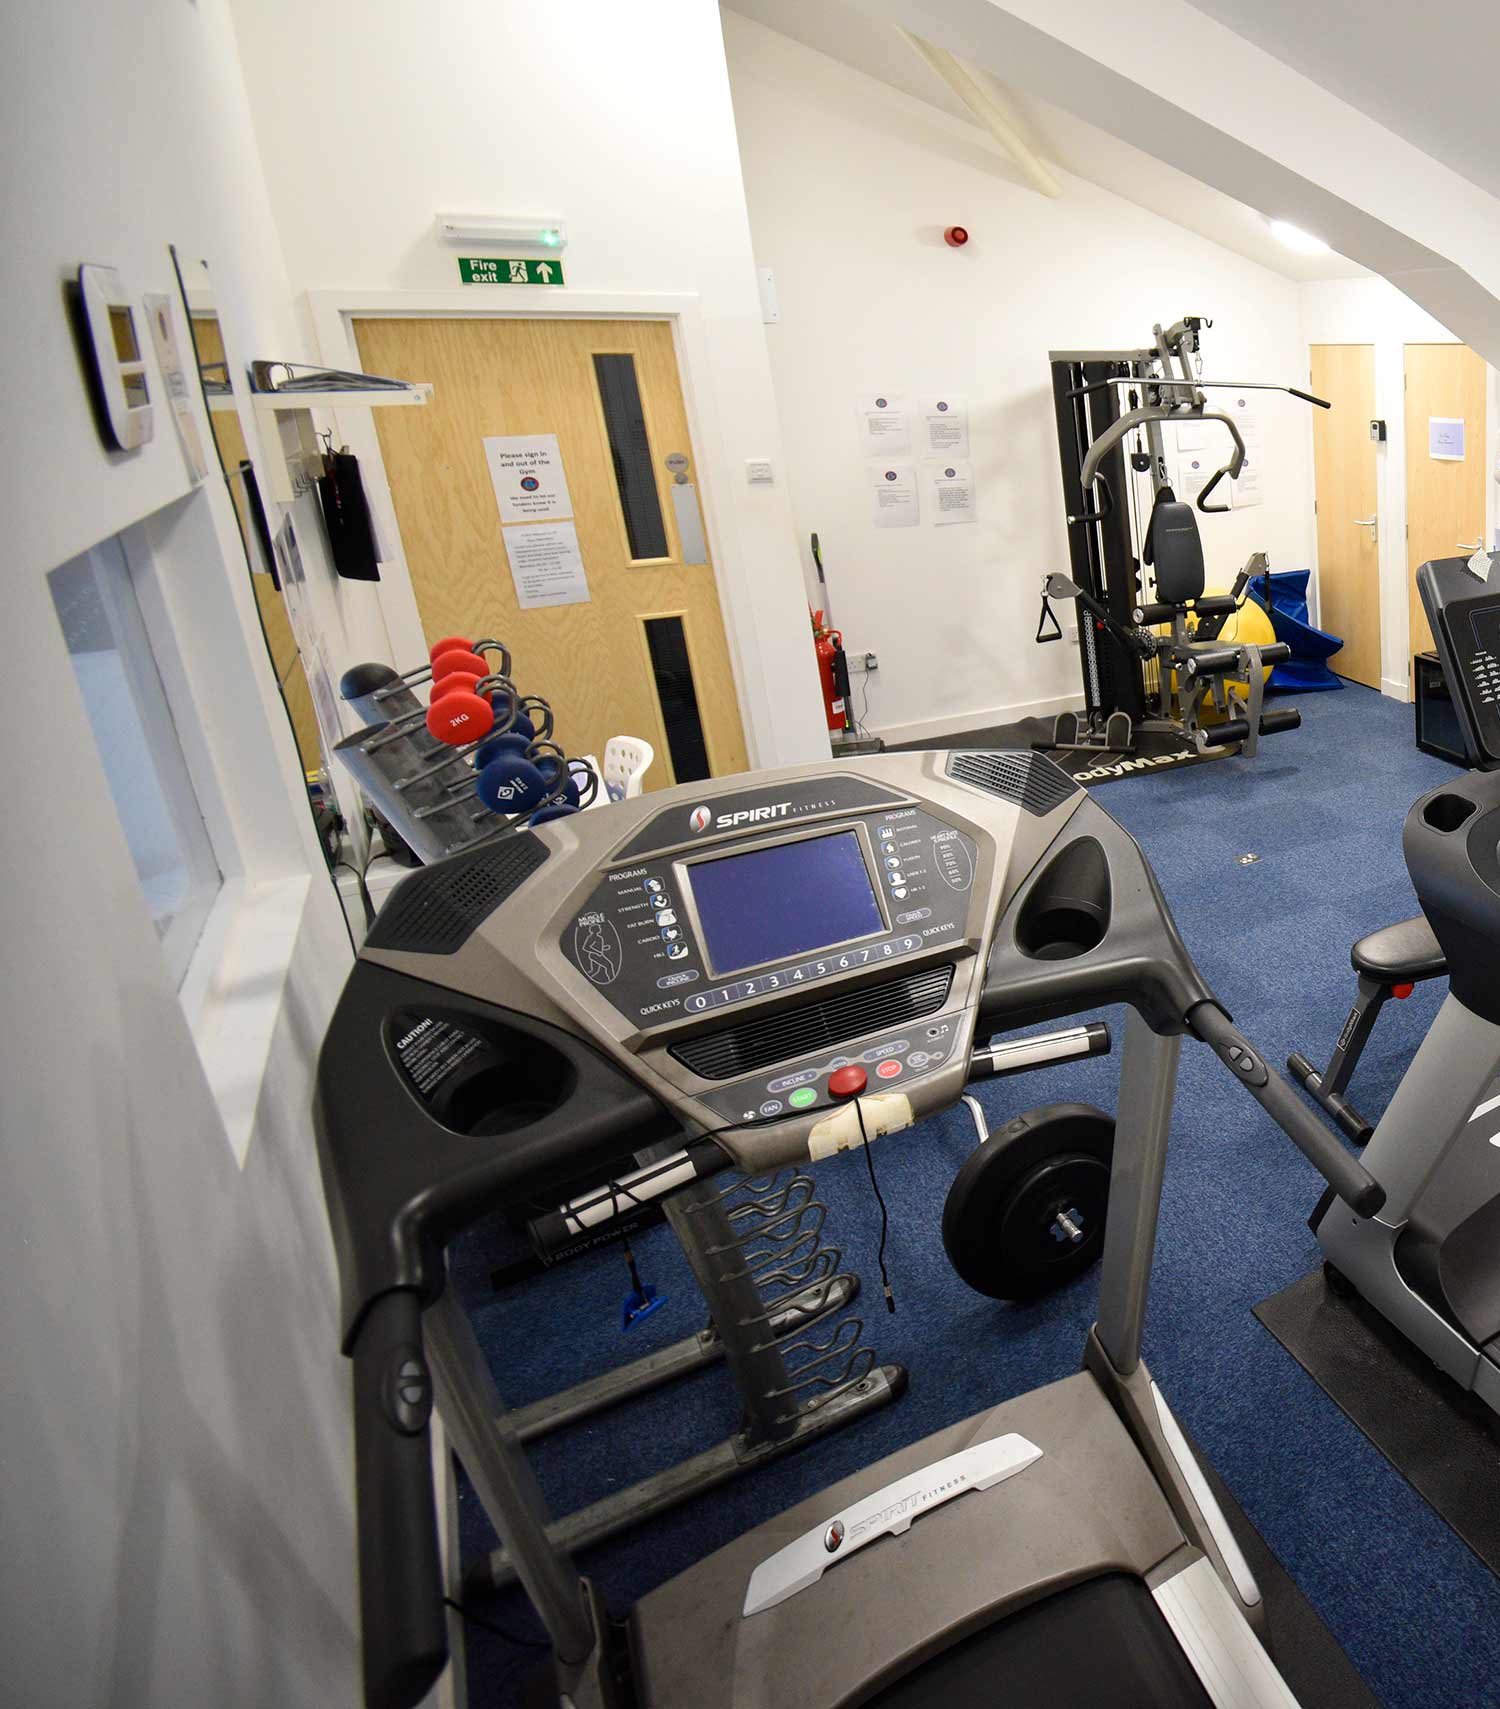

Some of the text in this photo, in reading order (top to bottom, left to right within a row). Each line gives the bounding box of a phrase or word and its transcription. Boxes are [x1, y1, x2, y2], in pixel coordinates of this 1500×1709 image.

[470, 259, 497, 271] Fire
[472, 272, 498, 282] exit
[450, 713, 470, 727] 2KG
[1072, 749, 1198, 781] odyMax
[716, 800, 837, 829] SPIRIT FITNESS
[885, 809, 917, 821] PROGRAMS
[608, 868, 648, 882] PROGRAMS
[617, 886, 642, 895] MANUAL
[617, 902, 649, 913] STRENGTH
[578, 912, 606, 922] MUSCLE
[923, 922, 955, 937] QUICK KEYS
[637, 935, 661, 945] CARDIO
[695, 939, 913, 1009] 0 1 2 3 4 5 6 7 8 9
[640, 998, 681, 1016] QUICK KEYS
[396, 1018, 433, 1049] CAUTION!
[875, 1046, 895, 1057] SPEED
[880, 1064, 898, 1074] STOP
[781, 1075, 806, 1087] INCLINE
[792, 1092, 812, 1103] START
[763, 1104, 779, 1114] FAN
[556, 1222, 639, 1260] BODY POWER
[849, 1475, 966, 1539] SPIRIT FITNESS
